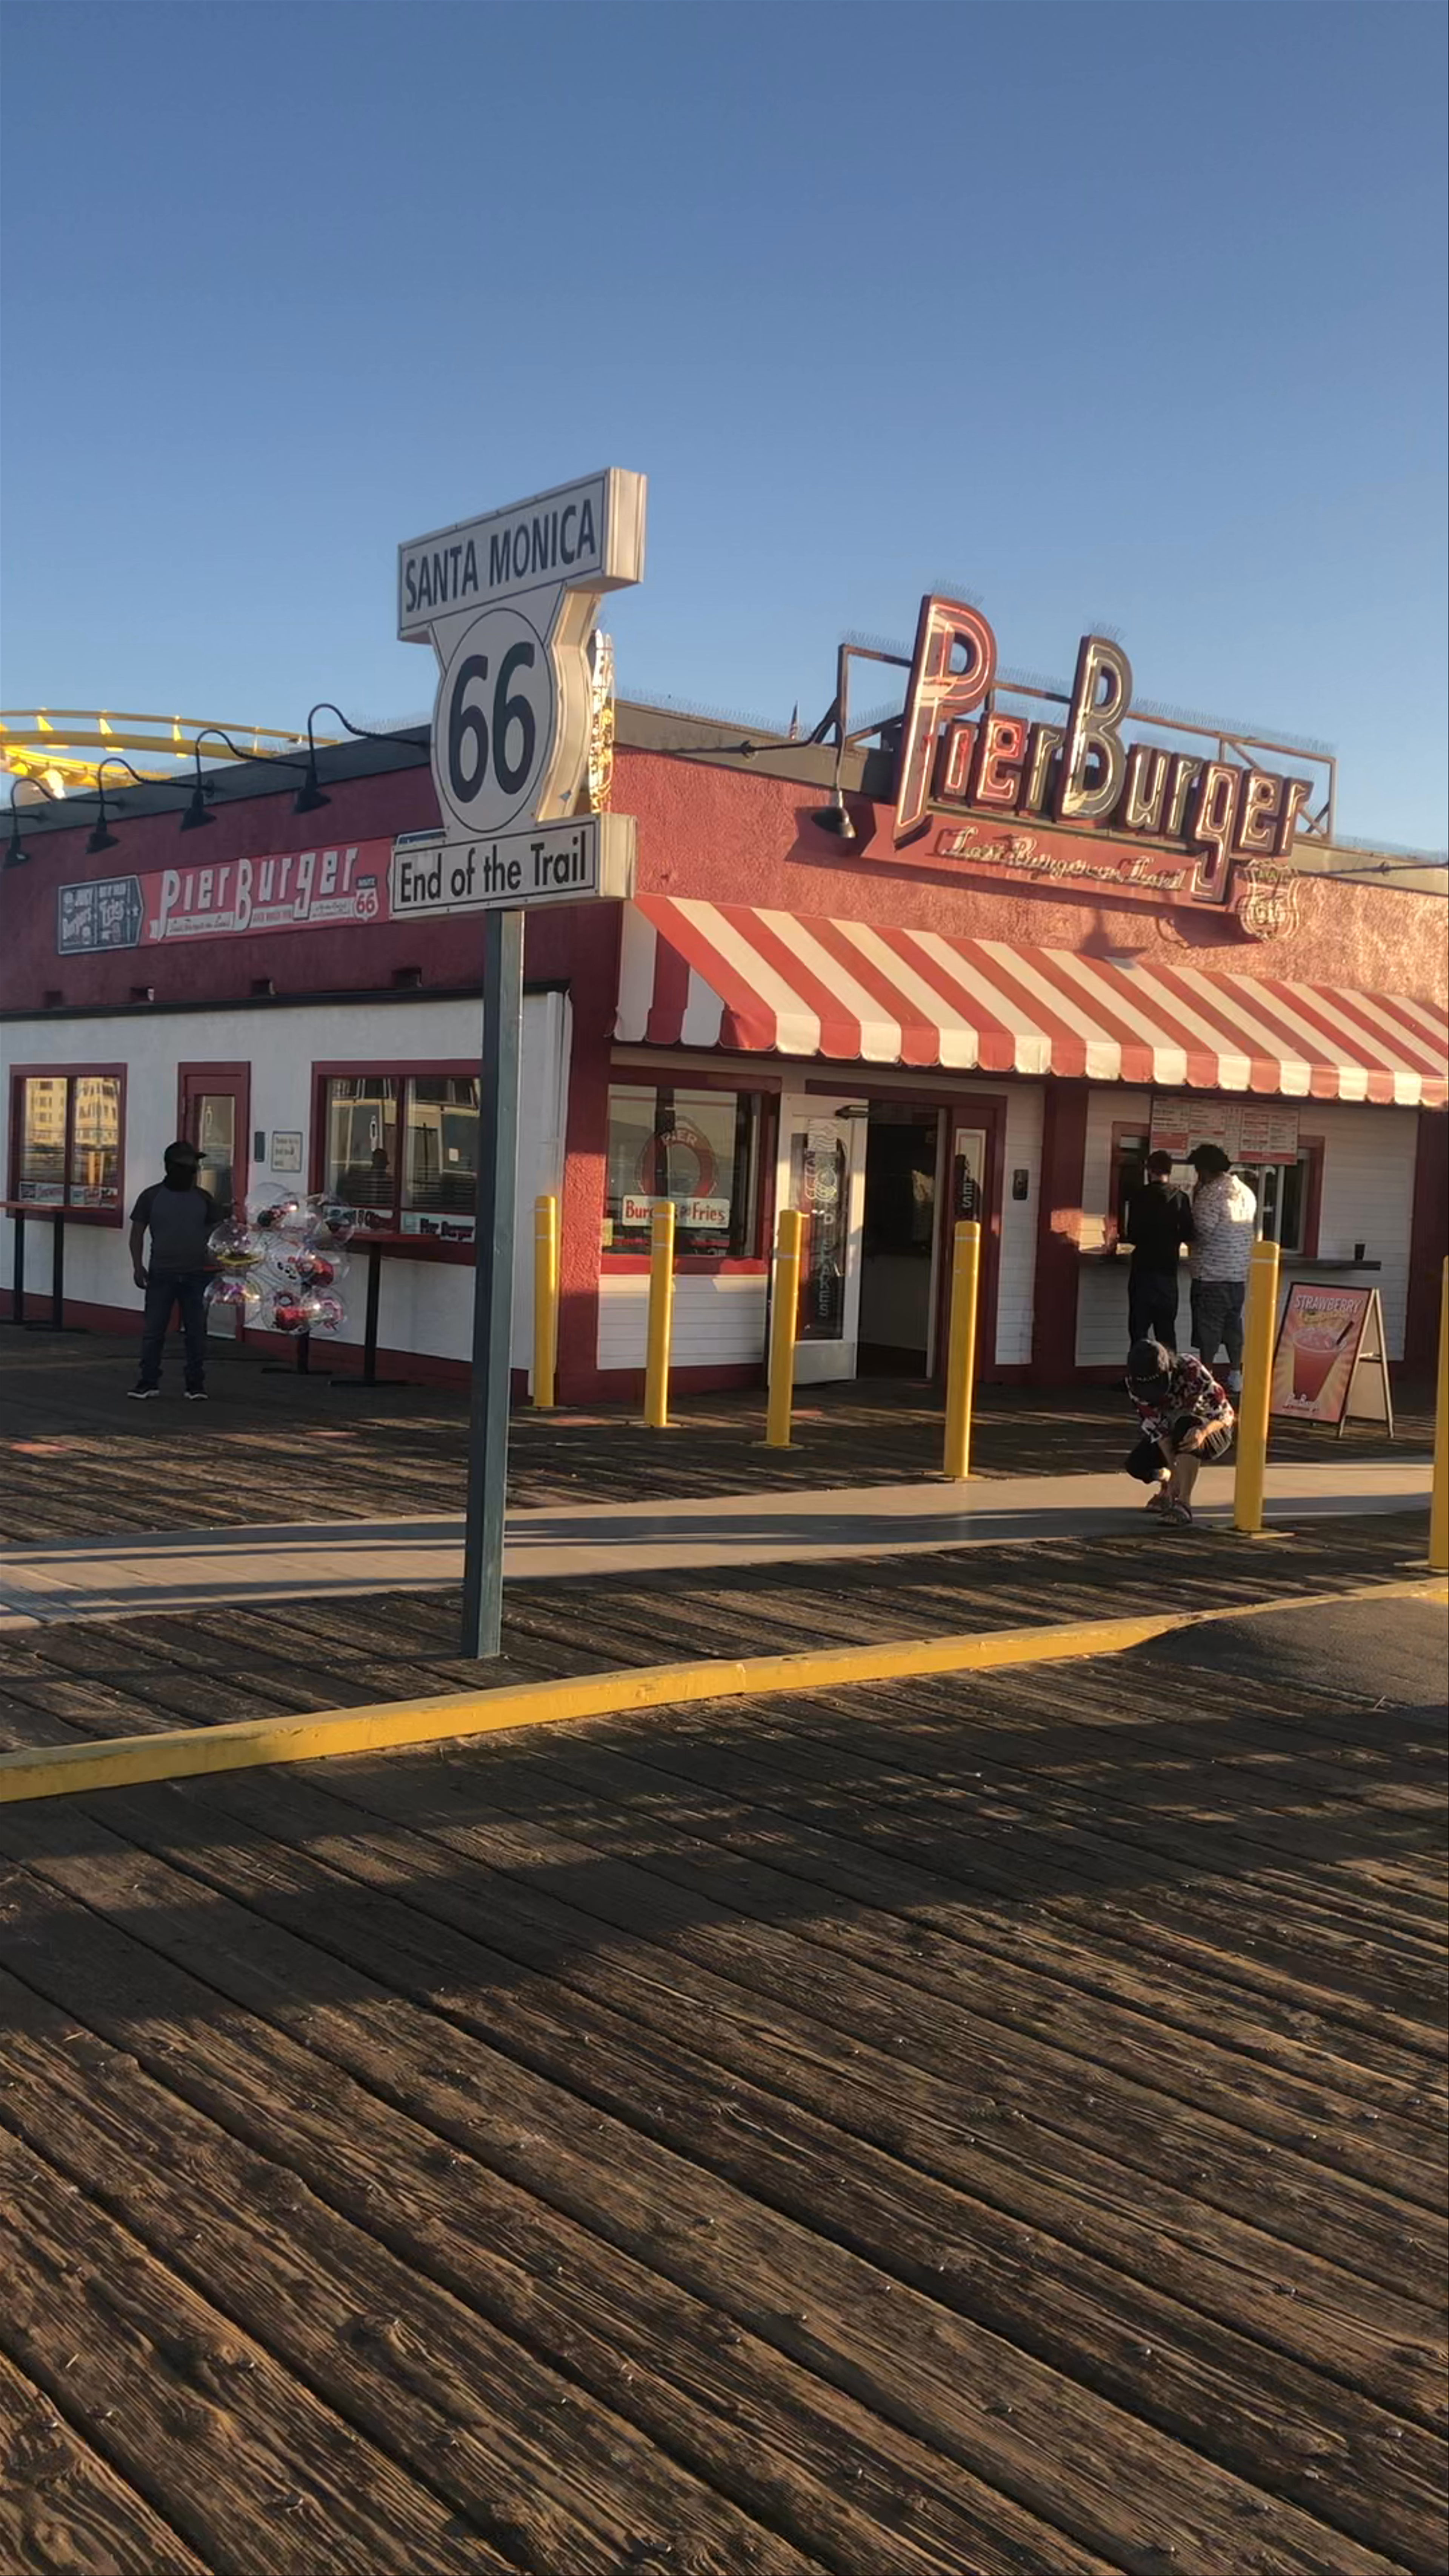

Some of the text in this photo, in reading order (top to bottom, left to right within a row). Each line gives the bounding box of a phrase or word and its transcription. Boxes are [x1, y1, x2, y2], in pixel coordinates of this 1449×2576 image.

[405, 498, 596, 613] SANTA MONICA
[448, 641, 536, 804] 66
[234, 847, 358, 932] Burger
[401, 830, 586, 903] End of the Trail
[356, 892, 376, 914] 66
[660, 1129, 698, 1146] PIER
[692, 1201, 725, 1222] Fries
[1295, 1295, 1363, 1313] STRAWBERRY
